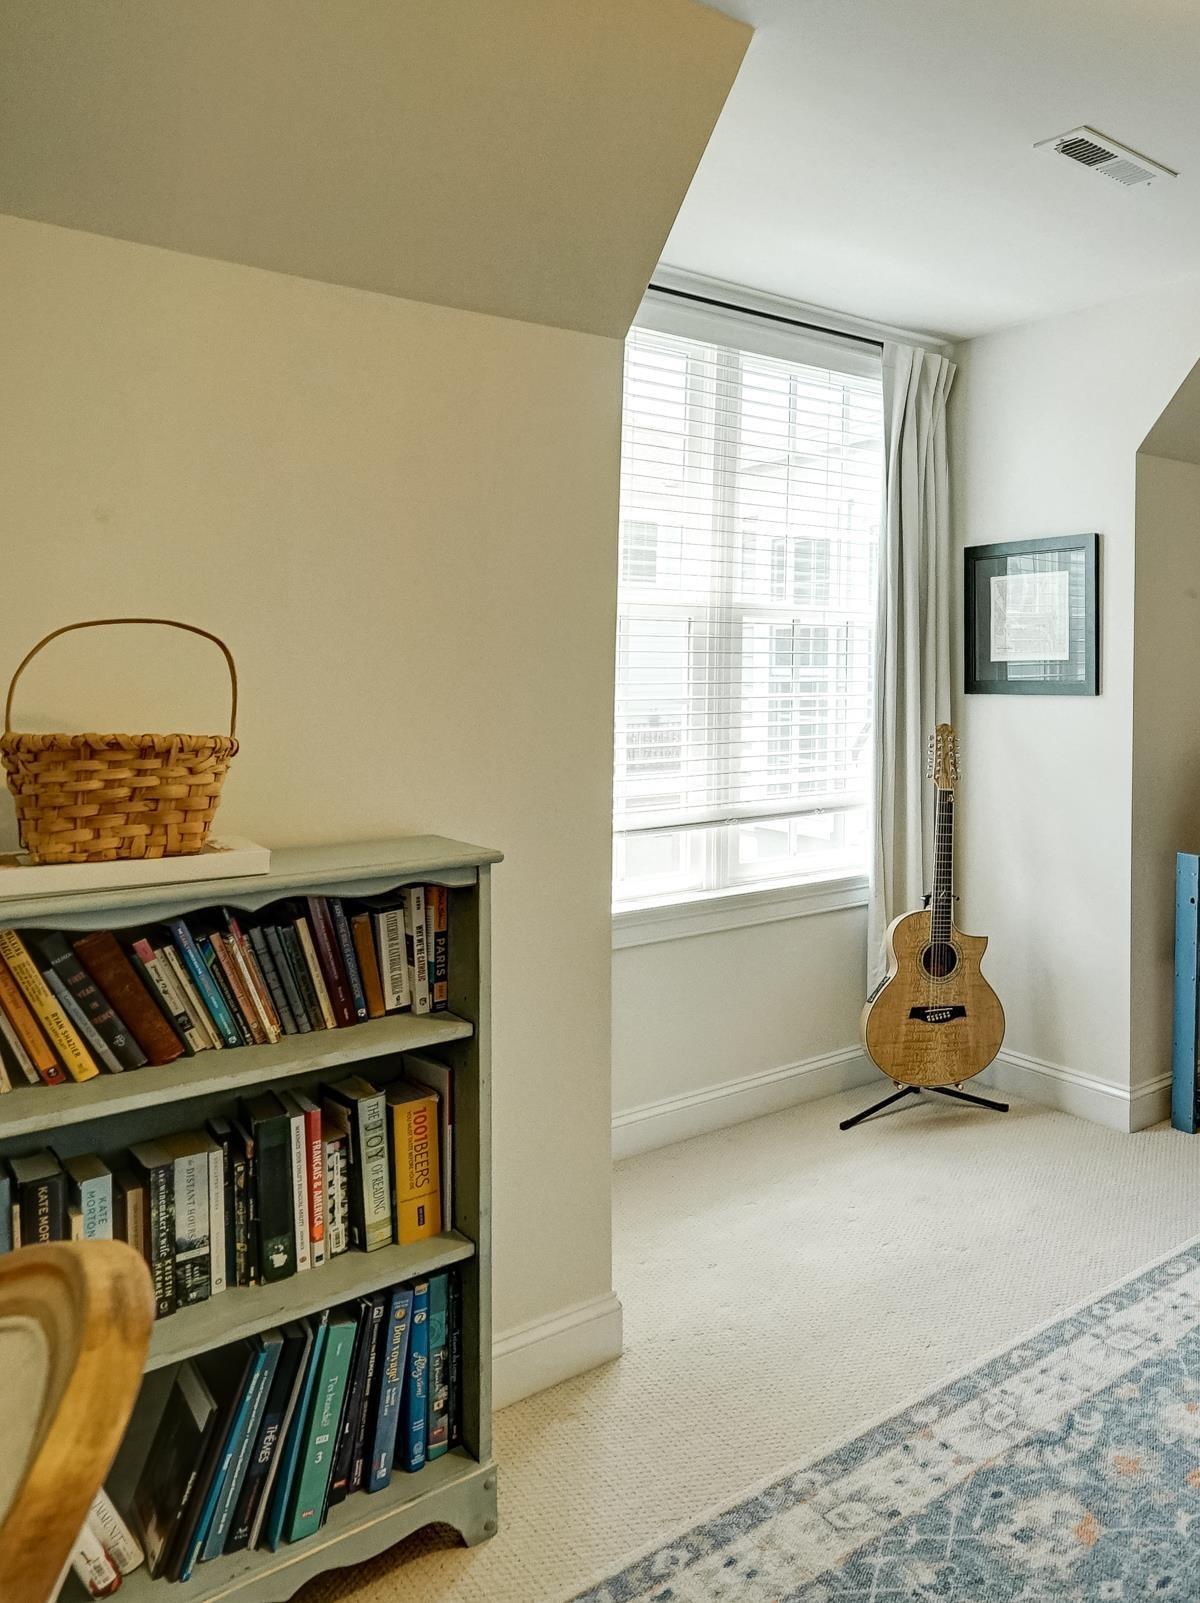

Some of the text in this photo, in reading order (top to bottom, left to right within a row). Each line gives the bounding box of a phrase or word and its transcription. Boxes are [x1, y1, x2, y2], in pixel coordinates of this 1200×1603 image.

[415, 925, 423, 939] WHY
[417, 955, 426, 981] CATHOLIC
[436, 937, 446, 976] PARIS
[51, 1012, 81, 1059] RYAN SHAZIER
[311, 1140, 322, 1179] FRANÇAIS
[364, 1101, 386, 1214] THE JOY OF READING
[37, 1185, 49, 1215] KATE
[186, 1167, 195, 1207] DISTANT
[85, 1190, 97, 1237] MORTON
[97, 1196, 108, 1224] KATE
[158, 1183, 168, 1237] winemaker's
[186, 1209, 196, 1239] HOURS
[313, 1190, 324, 1227] AMERICA
[159, 1239, 168, 1257] wife
[163, 1259, 172, 1297] KRISTIN
[386, 1324, 406, 1384] Bon voyage!
[315, 1451, 323, 1463] 3
